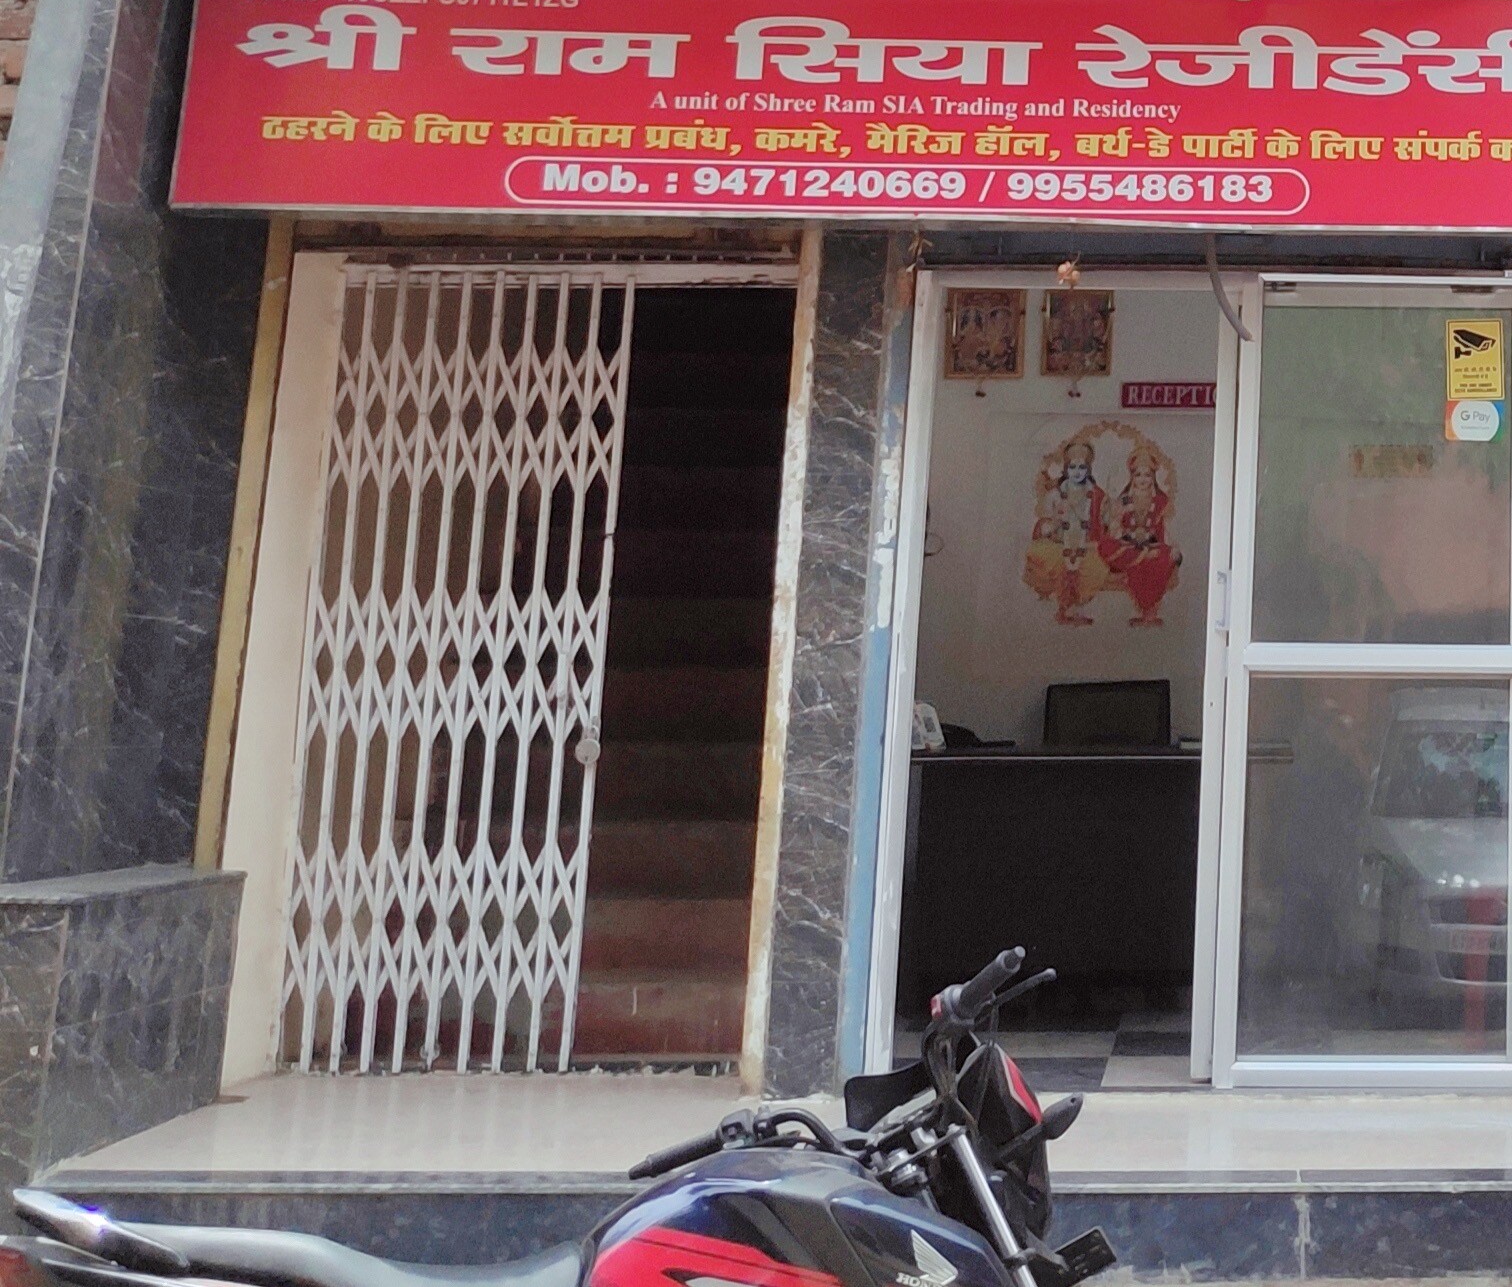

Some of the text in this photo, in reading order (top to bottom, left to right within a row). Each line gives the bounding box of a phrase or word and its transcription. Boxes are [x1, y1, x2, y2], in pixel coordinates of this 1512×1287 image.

[235, 4, 418, 72] श्री
[450, 27, 691, 79] राम
[726, 16, 1043, 86] सिया
[650, 91, 1181, 123] A unit of Shree Ram SIA Trading and Residency
[261, 110, 360, 142] ठहरने
[366, 111, 406, 143] के
[414, 113, 494, 145] लिए
[645, 118, 742, 157] प्रबंध,
[754, 122, 851, 159] कमरे,
[865, 122, 966, 155] मैरिज
[974, 125, 1061, 162] हॉल,
[1074, 127, 1173, 158] बर्थ-डे
[1182, 128, 1259, 159] पार्टी
[1264, 128, 1302, 159] के
[1309, 130, 1385, 161] लिए
[1393, 130, 1483, 161] संपर्क
[542, 163, 650, 193] Mob.
[693, 169, 967, 200] 9471240669
[978, 171, 996, 203] /
[1007, 172, 1274, 203] 9955486183
[1127, 385, 1217, 405] RECEPTI
[1460, 410, 1491, 423] G Pay
